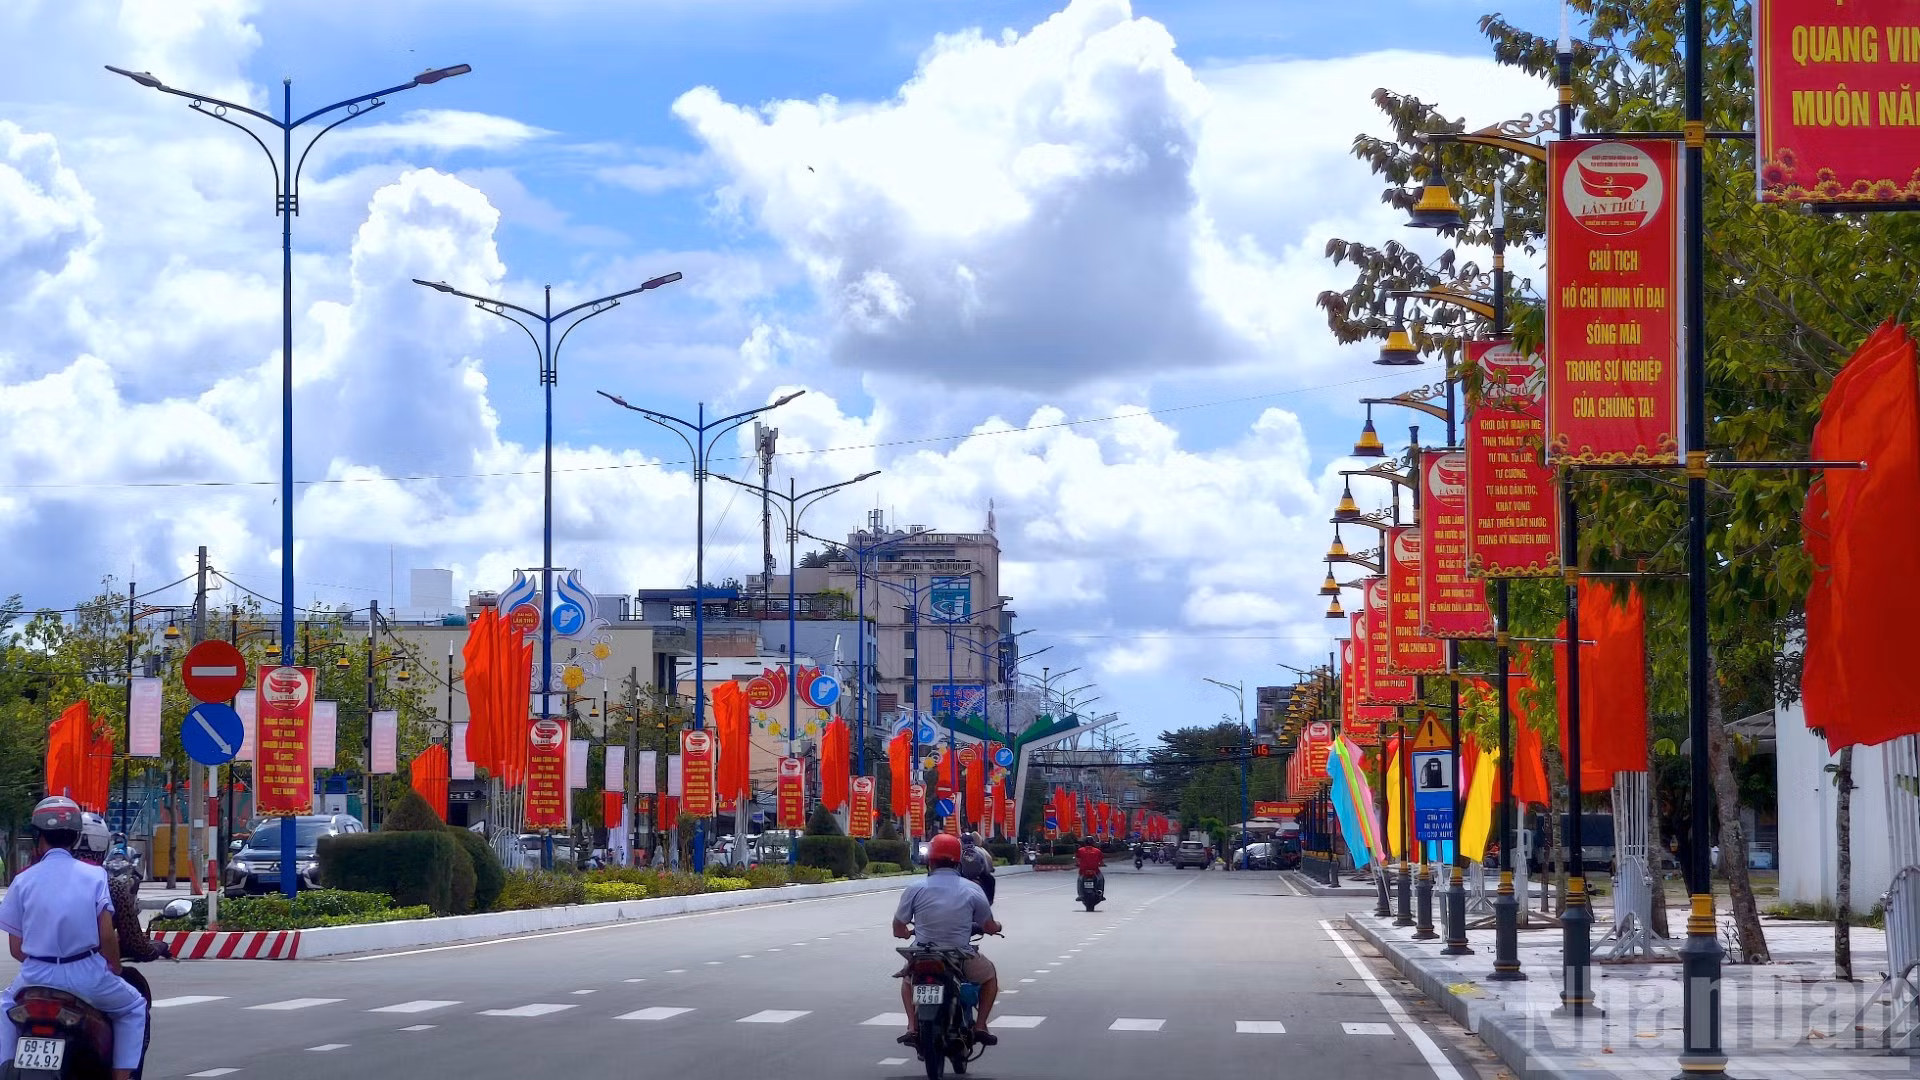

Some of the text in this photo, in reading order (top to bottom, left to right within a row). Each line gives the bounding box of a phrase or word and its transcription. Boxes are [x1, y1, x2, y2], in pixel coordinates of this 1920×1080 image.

[1792, 25, 1878, 66] QUANG
[1791, 83, 1920, 126] MUÔN NĂ
[1582, 201, 1606, 215] LẦN
[1612, 199, 1638, 212] THỨ
[1589, 244, 1638, 276] CHỦ TỊCH
[1562, 280, 1665, 313] HỒ CHÍ MINH VĨ ĐẠI
[1586, 316, 1641, 345] SỐNG MÃI
[1565, 357, 1662, 386] TRONG SỰ NGHIỆP
[1573, 390, 1655, 418] CỦA CHÚNG TA!
[916, 986, 940, 995] 69-F9
[17, 1053, 60, 1068] 424.92
[24, 1040, 57, 1054] 69-E1
